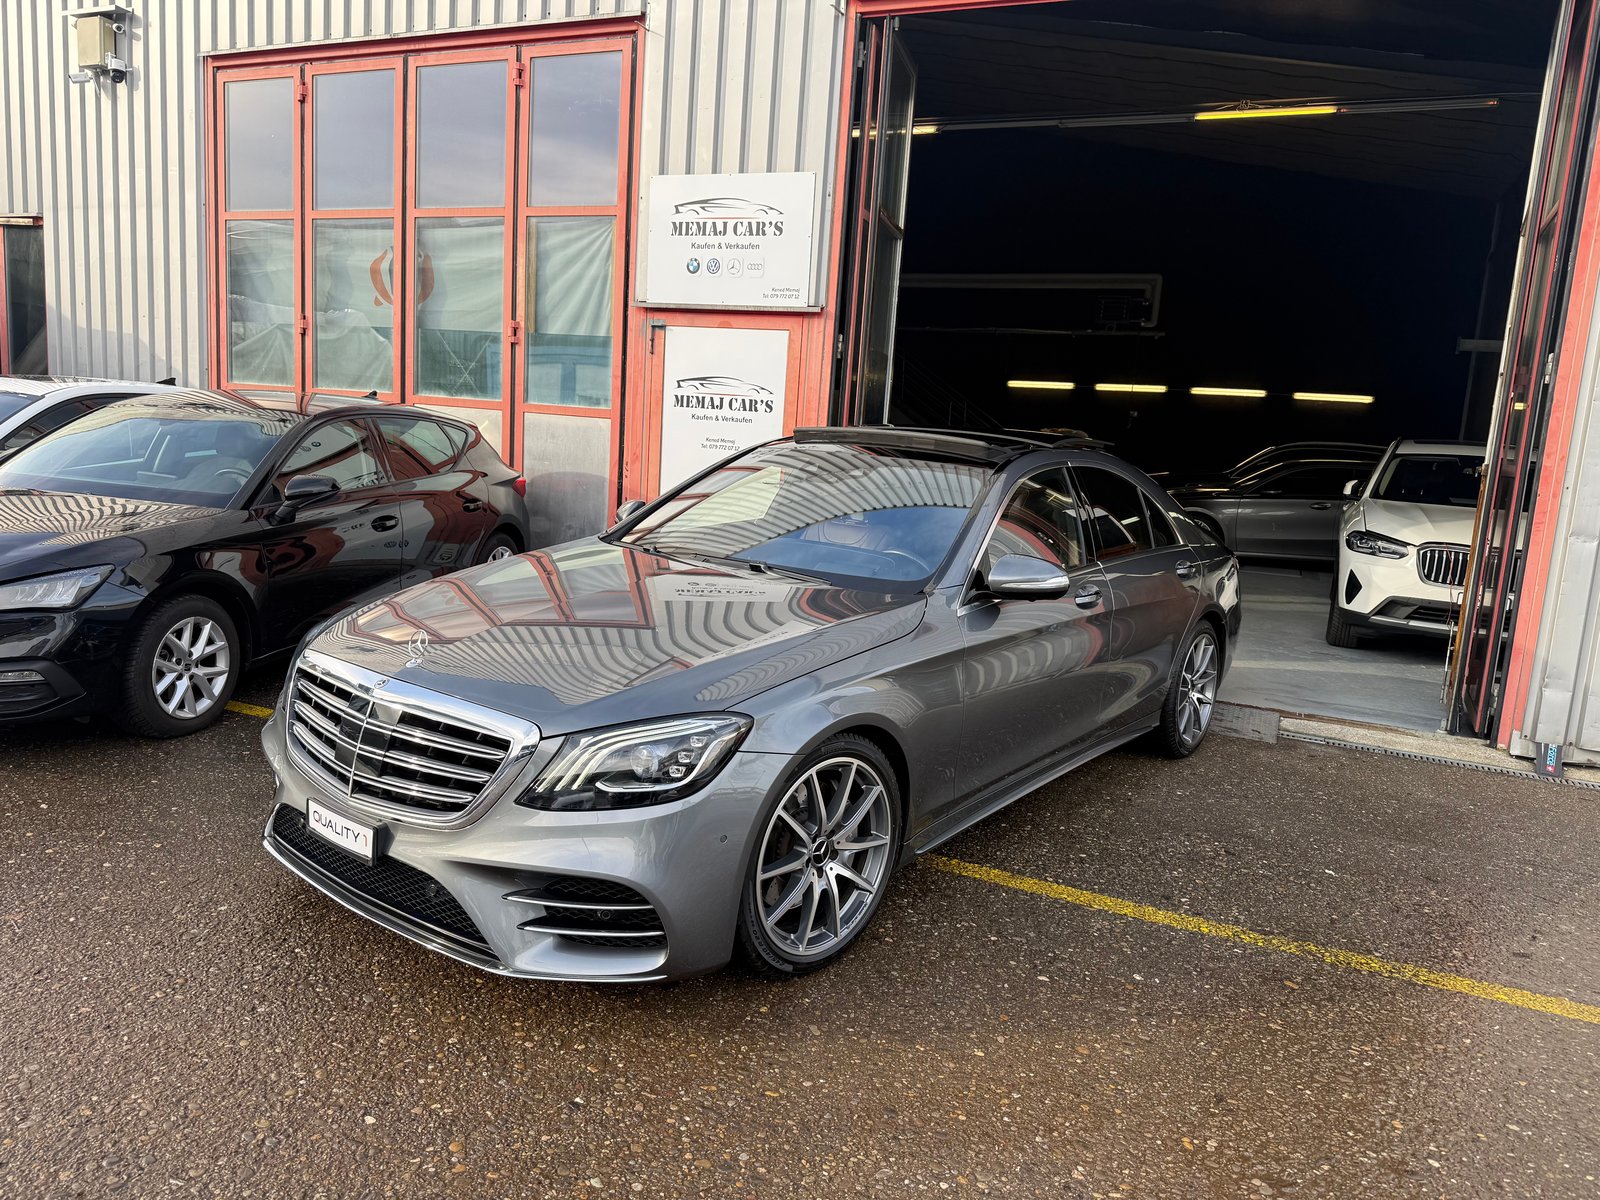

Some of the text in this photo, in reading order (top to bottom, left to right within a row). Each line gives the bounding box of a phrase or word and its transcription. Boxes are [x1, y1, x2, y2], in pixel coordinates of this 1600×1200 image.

[670, 220, 784, 237] MEMAJ CAR'S
[691, 242, 760, 250] Kaufen & Verkaufen
[673, 394, 774, 413] MEMAJ CAR'S
[691, 413, 713, 422] Kaufen
[721, 415, 753, 424] Verkaufen
[312, 810, 360, 843] QUALITY
